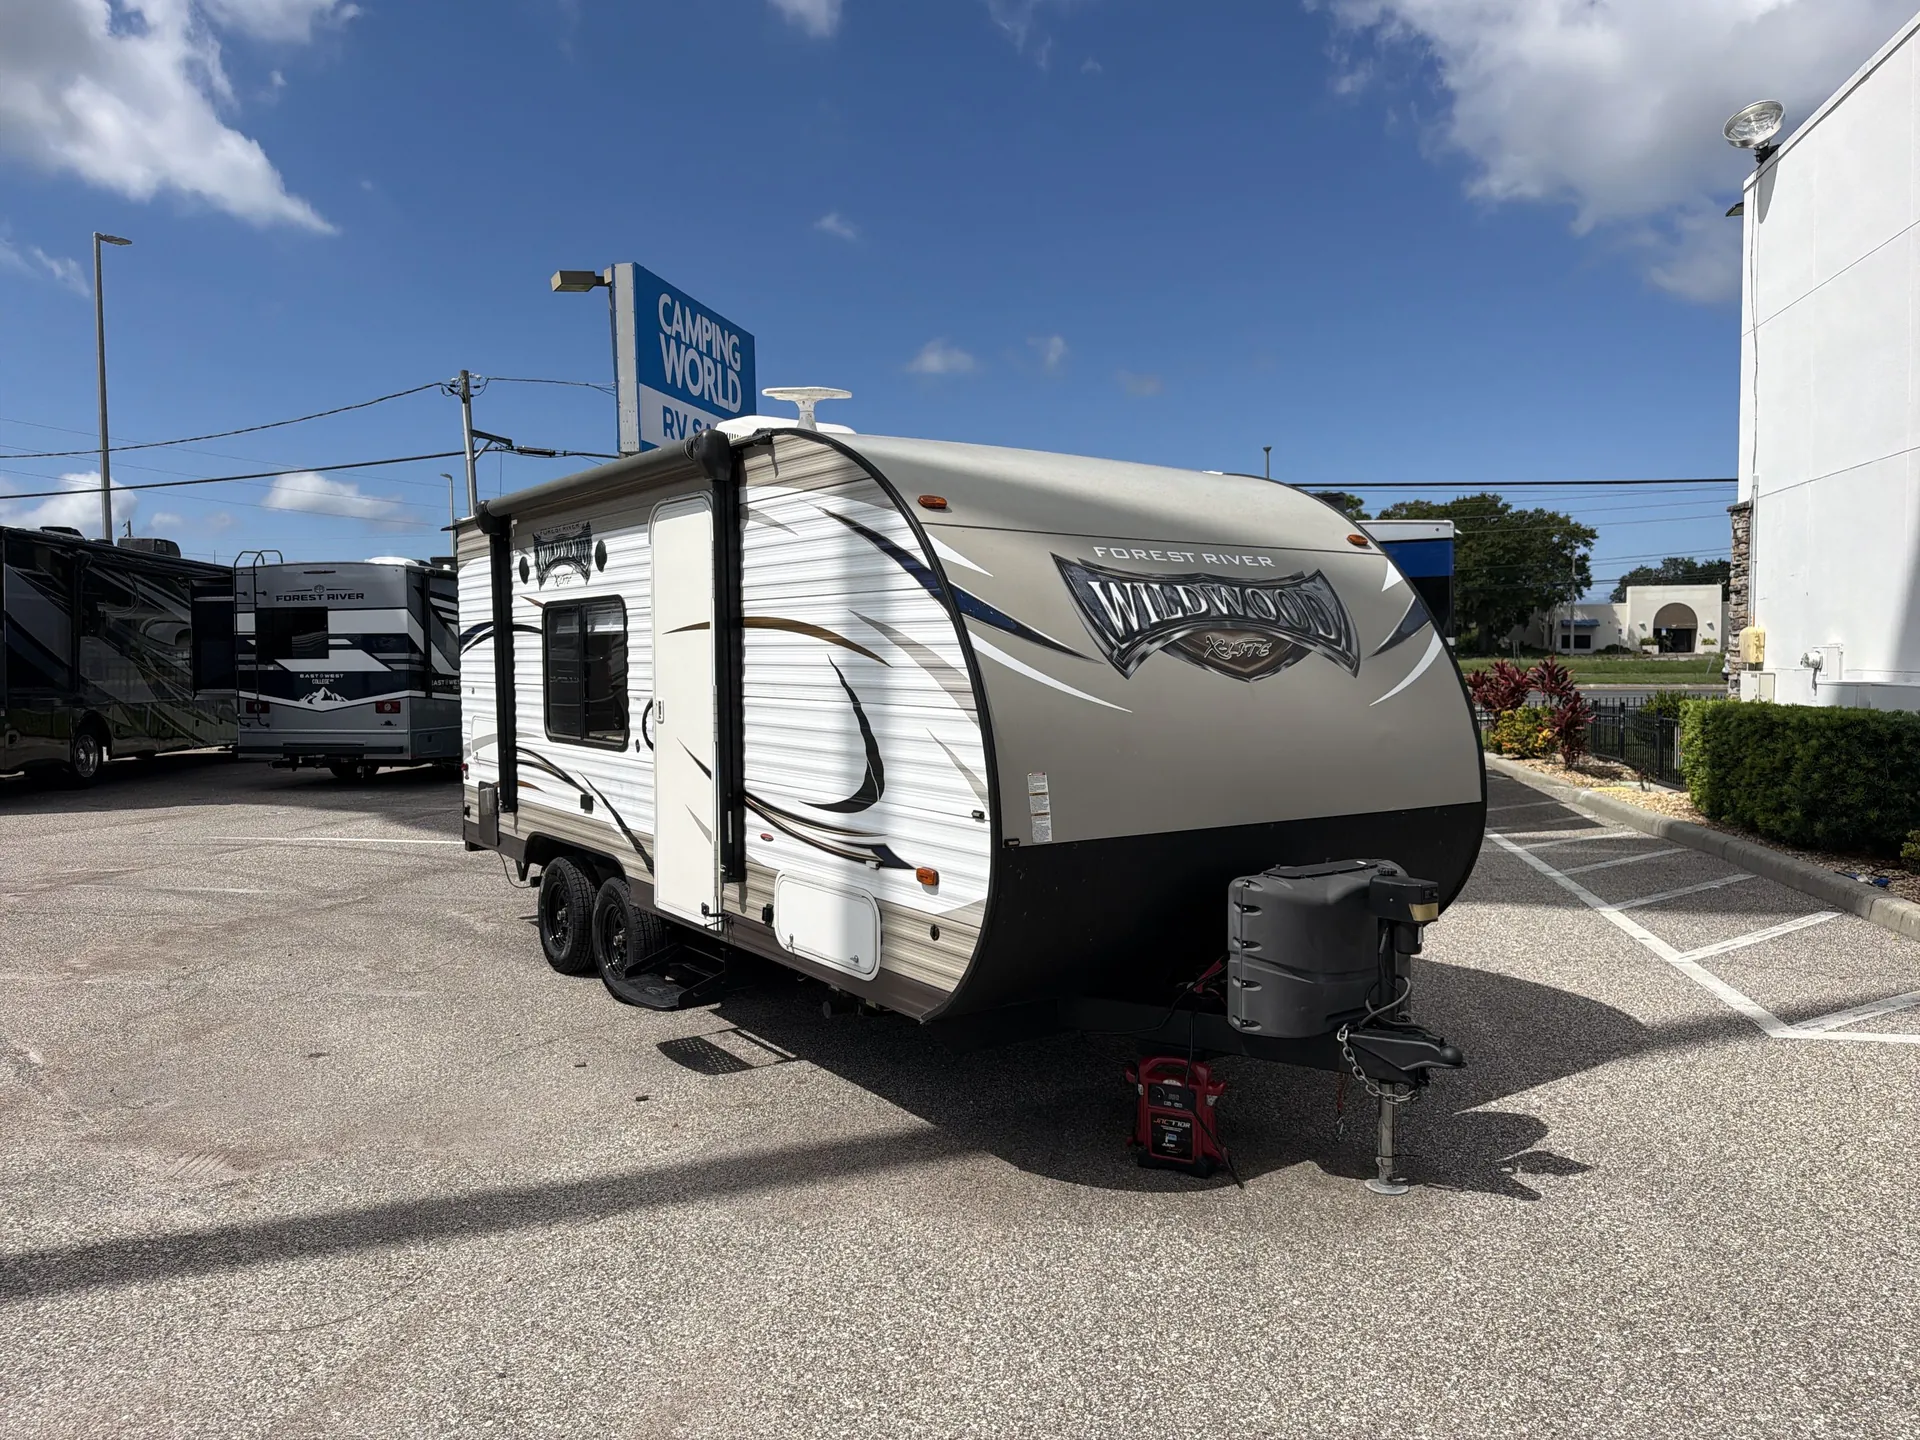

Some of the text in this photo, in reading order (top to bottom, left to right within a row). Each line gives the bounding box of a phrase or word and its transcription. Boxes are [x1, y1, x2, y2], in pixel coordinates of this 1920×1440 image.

[658, 293, 741, 371] CAMPING
[659, 332, 742, 413] WORLD
[663, 405, 687, 440] RV
[1093, 546, 1276, 568] FOREST RIVER
[275, 592, 365, 602] FOREST RIVER
[1088, 581, 1337, 639] WILDWOOD
[1203, 634, 1273, 660] X-LITE
